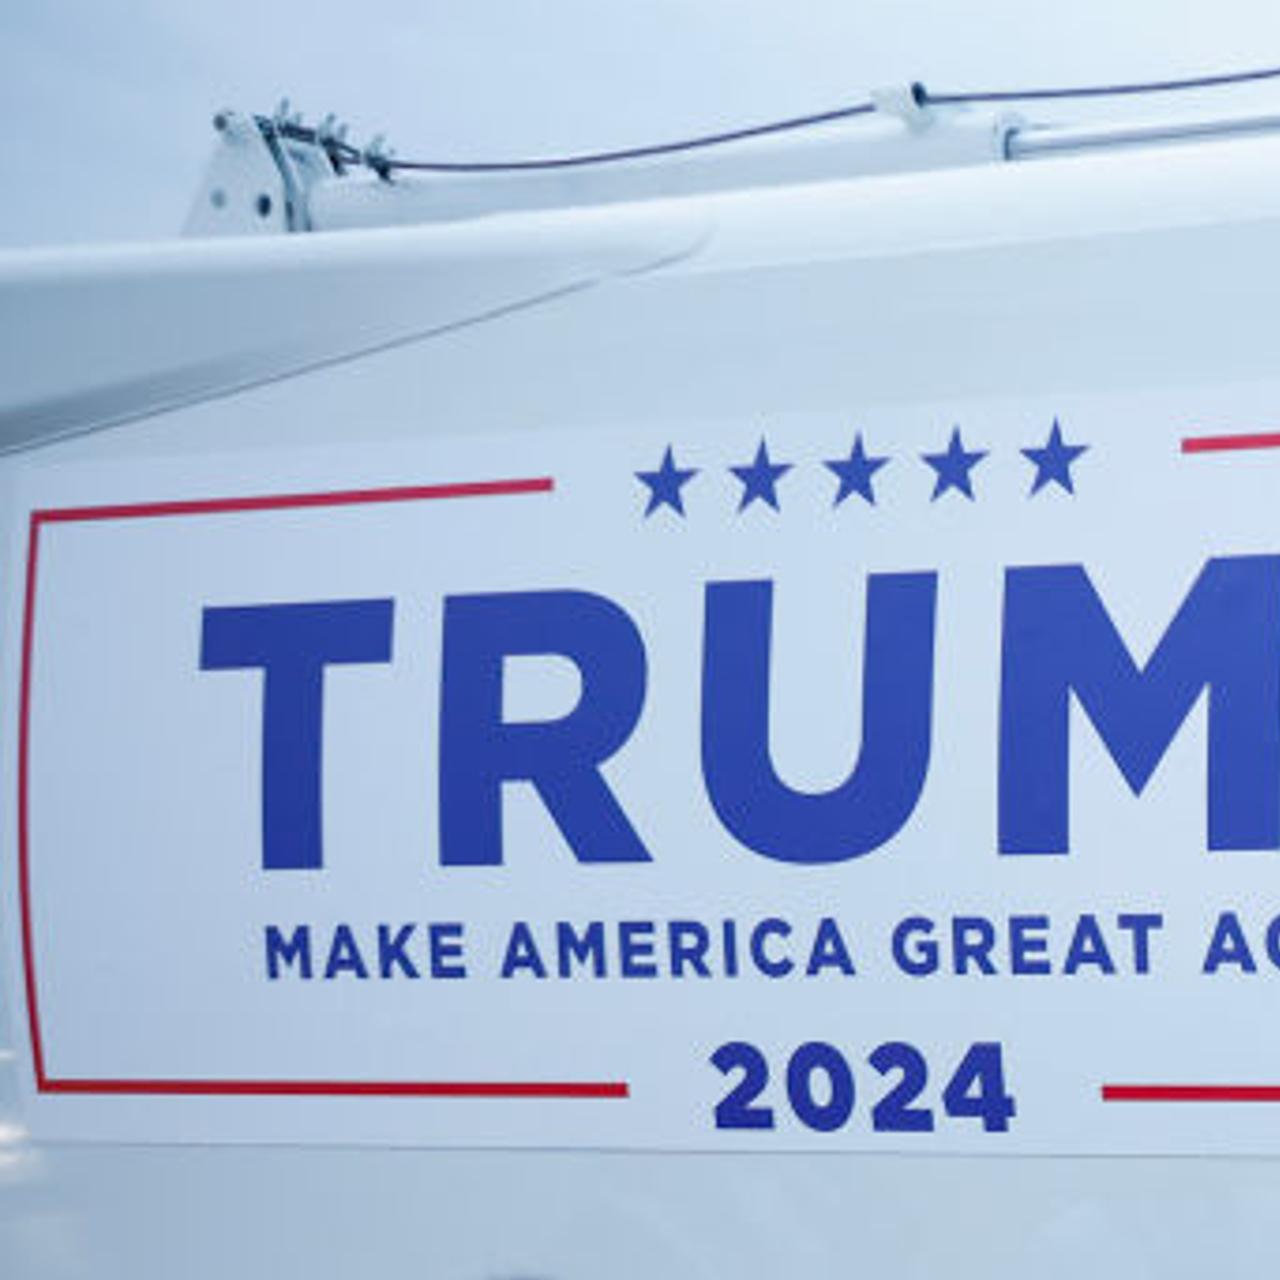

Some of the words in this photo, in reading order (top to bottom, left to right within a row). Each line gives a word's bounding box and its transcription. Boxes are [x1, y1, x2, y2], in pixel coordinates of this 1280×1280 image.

[264, 923, 468, 980] MAKE
[500, 918, 857, 979] AMERICA
[890, 914, 1164, 977] GREAT
[709, 1040, 1018, 1134] 2024
